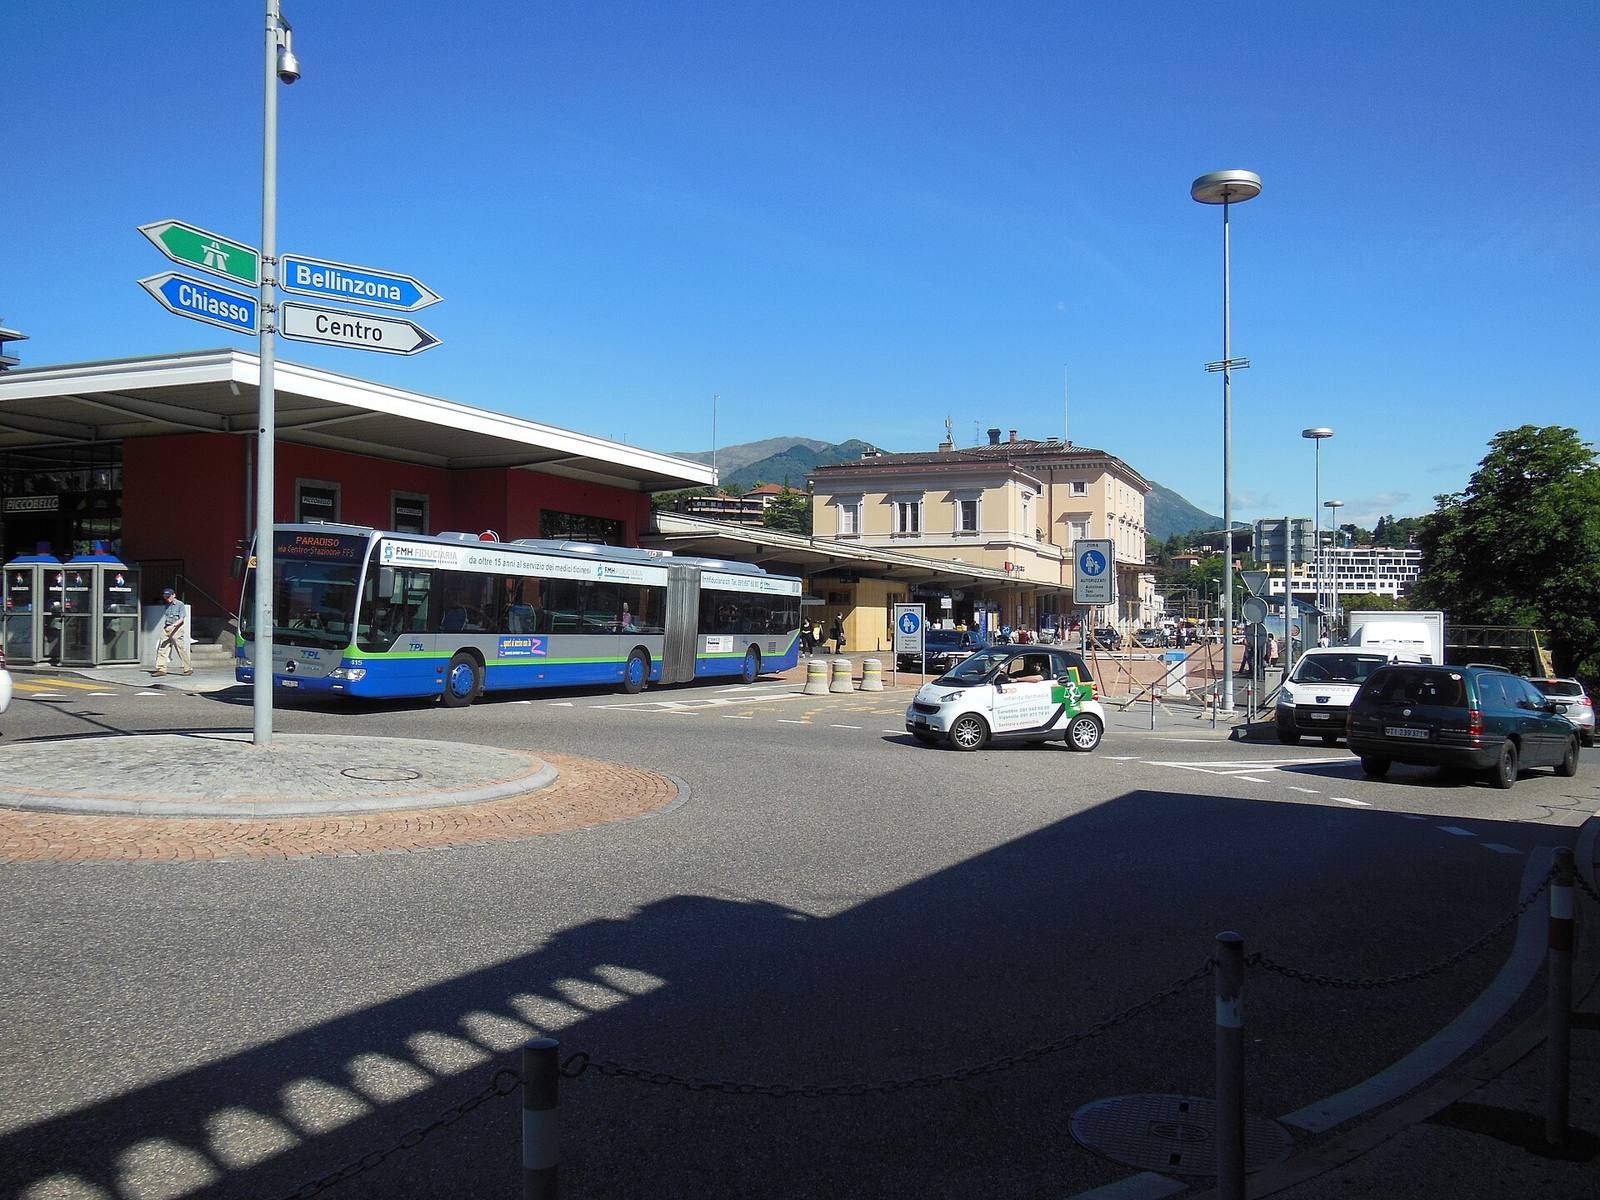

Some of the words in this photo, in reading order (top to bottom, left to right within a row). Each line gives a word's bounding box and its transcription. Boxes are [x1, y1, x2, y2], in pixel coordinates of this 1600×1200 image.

[296, 265, 401, 301] Bellinzona
[178, 284, 249, 323] Chiasso
[315, 314, 383, 342] Centro
[6, 498, 59, 510] PICCOBELLO
[296, 536, 340, 546] PARADISO
[396, 546, 414, 556] FMH
[415, 548, 458, 560] FIDUCIARIA
[468, 556, 477, 564] da
[478, 557, 492, 566] oltre
[494, 558, 502, 566] 15
[502, 559, 516, 568] anni
[516, 560, 523, 568] al
[523, 560, 544, 570] servizio
[546, 562, 554, 571] dei
[556, 563, 572, 573] medici
[408, 643, 424, 652] TPL
[300, 650, 320, 660] TPL
